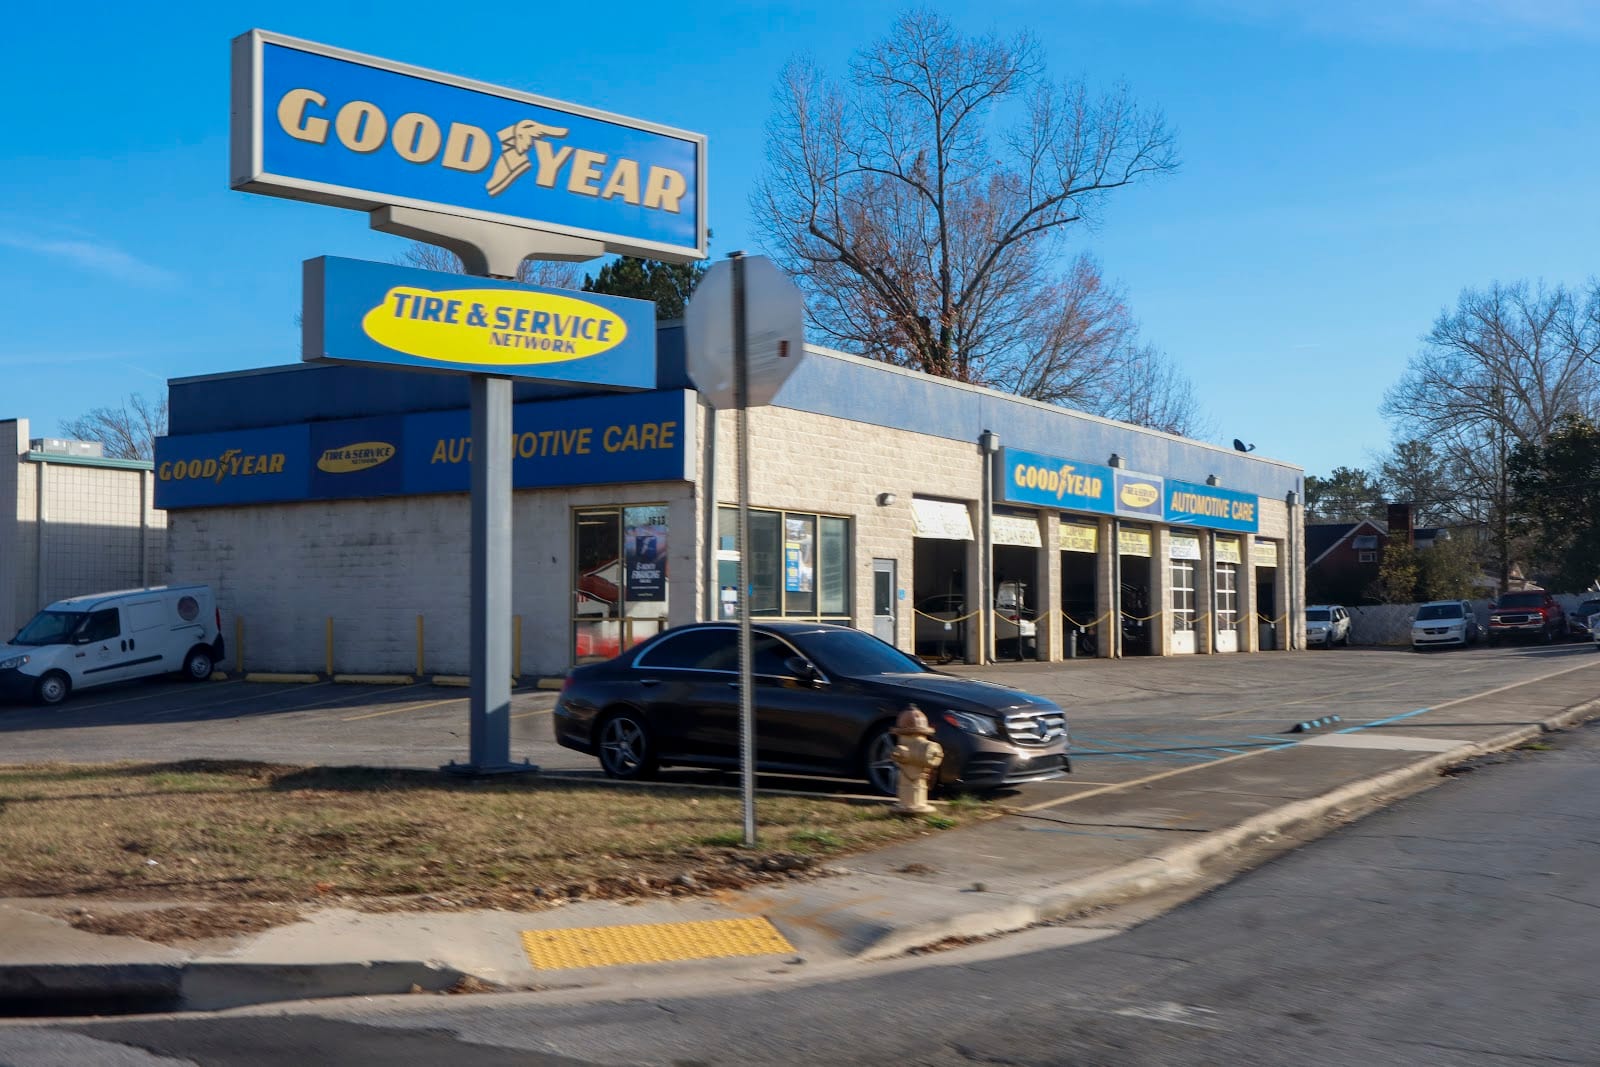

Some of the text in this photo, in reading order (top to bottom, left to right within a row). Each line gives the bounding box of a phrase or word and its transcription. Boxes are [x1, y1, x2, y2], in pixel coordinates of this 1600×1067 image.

[277, 88, 687, 214] GOODYEAR
[393, 292, 613, 343] TIRE & SERVICE
[489, 331, 577, 354] NETWORK
[325, 451, 344, 461] TIRE
[353, 447, 391, 459] SERVICE
[431, 421, 677, 464] AUTOTIVE CARE
[159, 449, 285, 484] GOODYEAR
[1015, 464, 1102, 500] GOODYEAR
[1171, 491, 1253, 522] AUTOMOTIVE CARE
